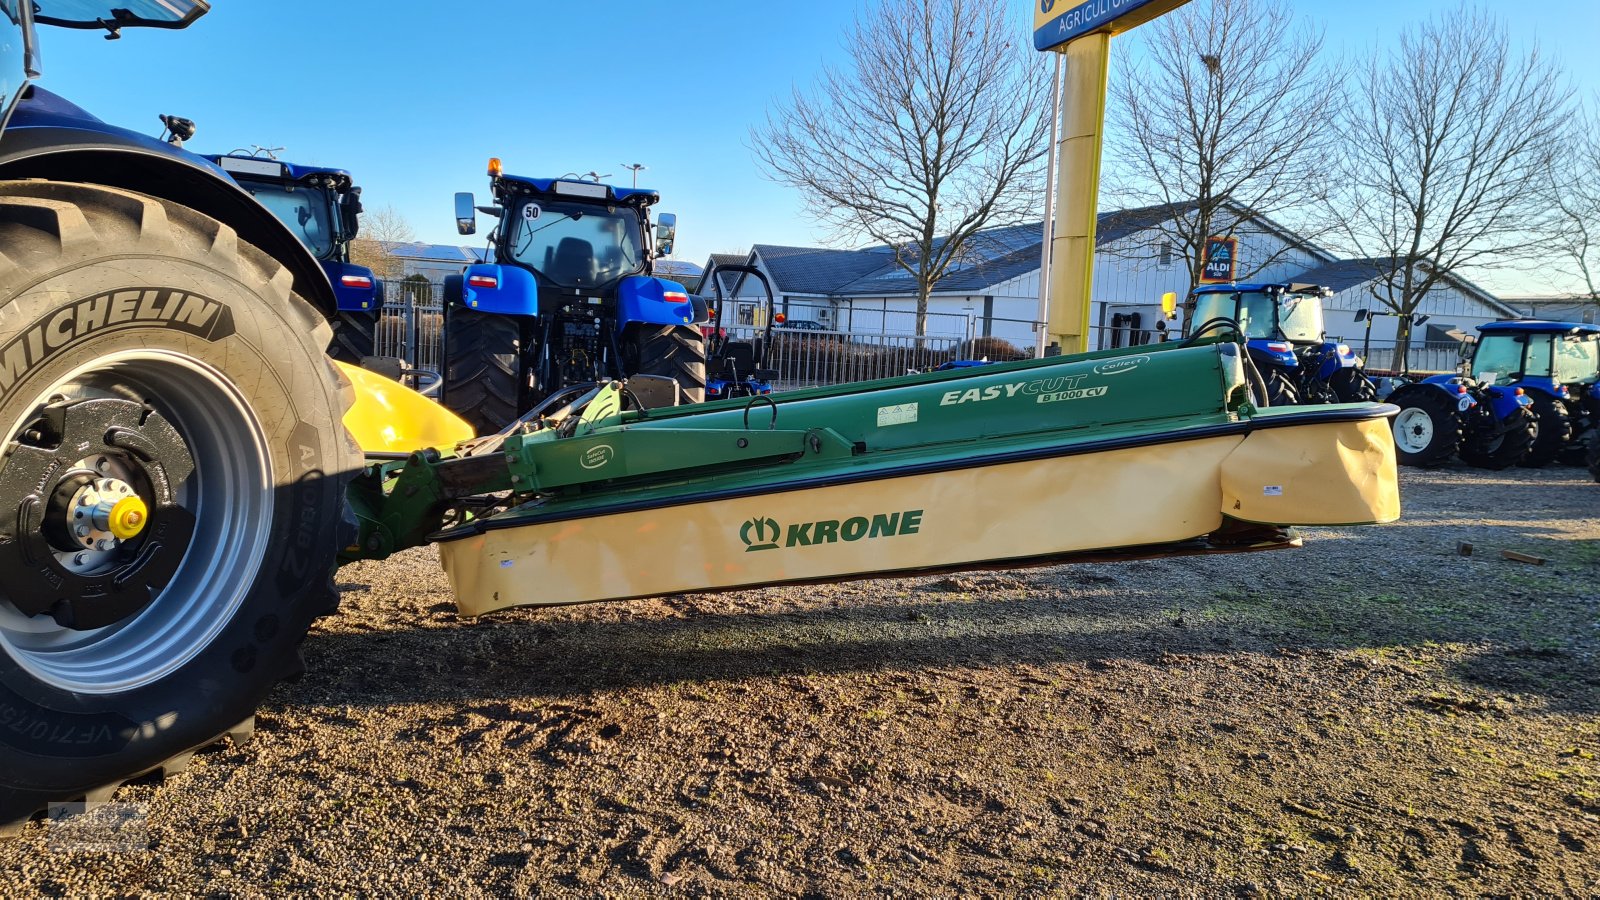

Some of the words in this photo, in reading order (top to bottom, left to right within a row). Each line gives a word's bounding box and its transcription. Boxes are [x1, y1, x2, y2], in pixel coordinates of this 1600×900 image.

[525, 206, 539, 218] 50
[1206, 262, 1230, 271] ALDI
[0, 290, 219, 394] MICHELIN
[1102, 359, 1141, 370] Collect
[1055, 390, 1083, 400] 1000
[1086, 388, 1103, 396] CV
[785, 510, 924, 547] KRONE
